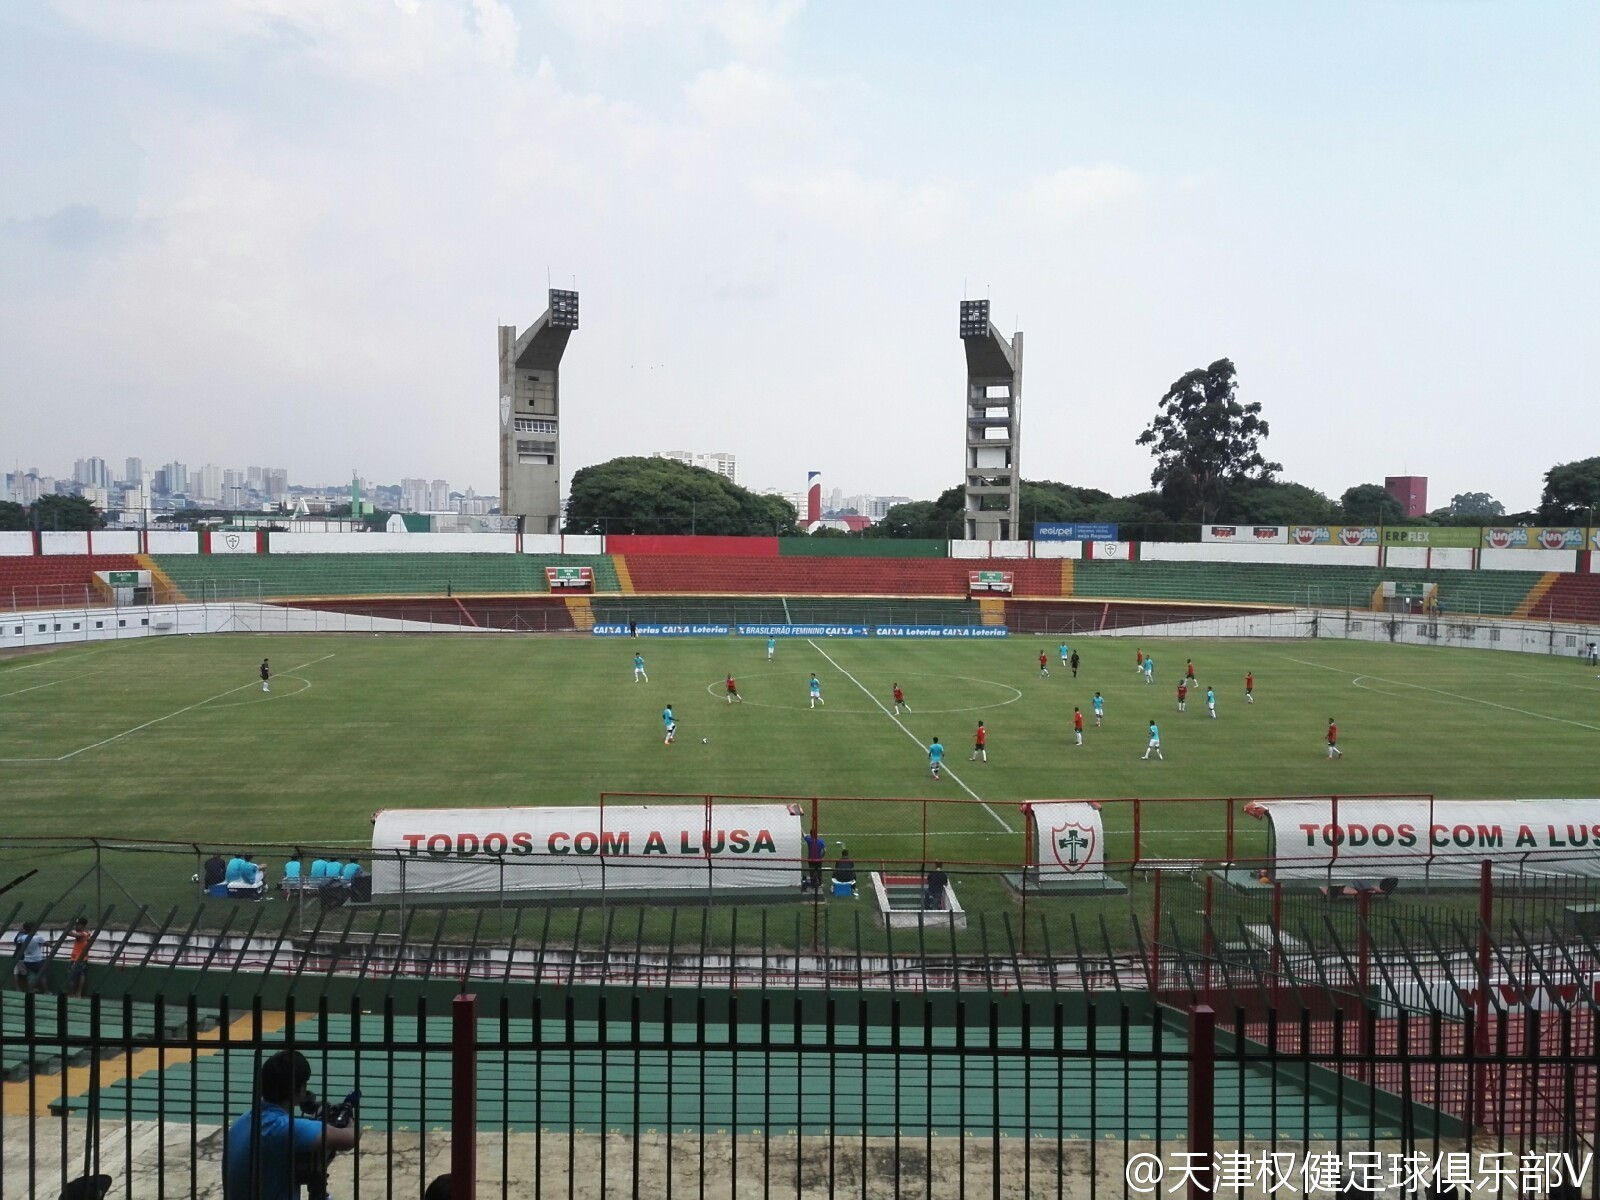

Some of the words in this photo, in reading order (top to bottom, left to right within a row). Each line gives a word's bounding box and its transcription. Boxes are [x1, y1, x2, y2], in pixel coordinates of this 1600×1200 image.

[593, 626, 621, 634] CAIXA
[692, 625, 728, 633] Loterias
[745, 625, 790, 634] BRASILEIRÃO
[791, 627, 825, 635] FEMININO
[876, 628, 904, 636] CAIXA
[905, 628, 941, 636] Loterias
[942, 628, 970, 636] CAIXA
[971, 628, 1006, 636] Loterias
[1299, 824, 1417, 847] TODOS
[1429, 824, 1503, 848] COM
[1515, 824, 1538, 848] A
[402, 832, 533, 857] TODOS
[547, 831, 629, 856] COM
[643, 830, 668, 855] A
[680, 829, 776, 855] LUSA
